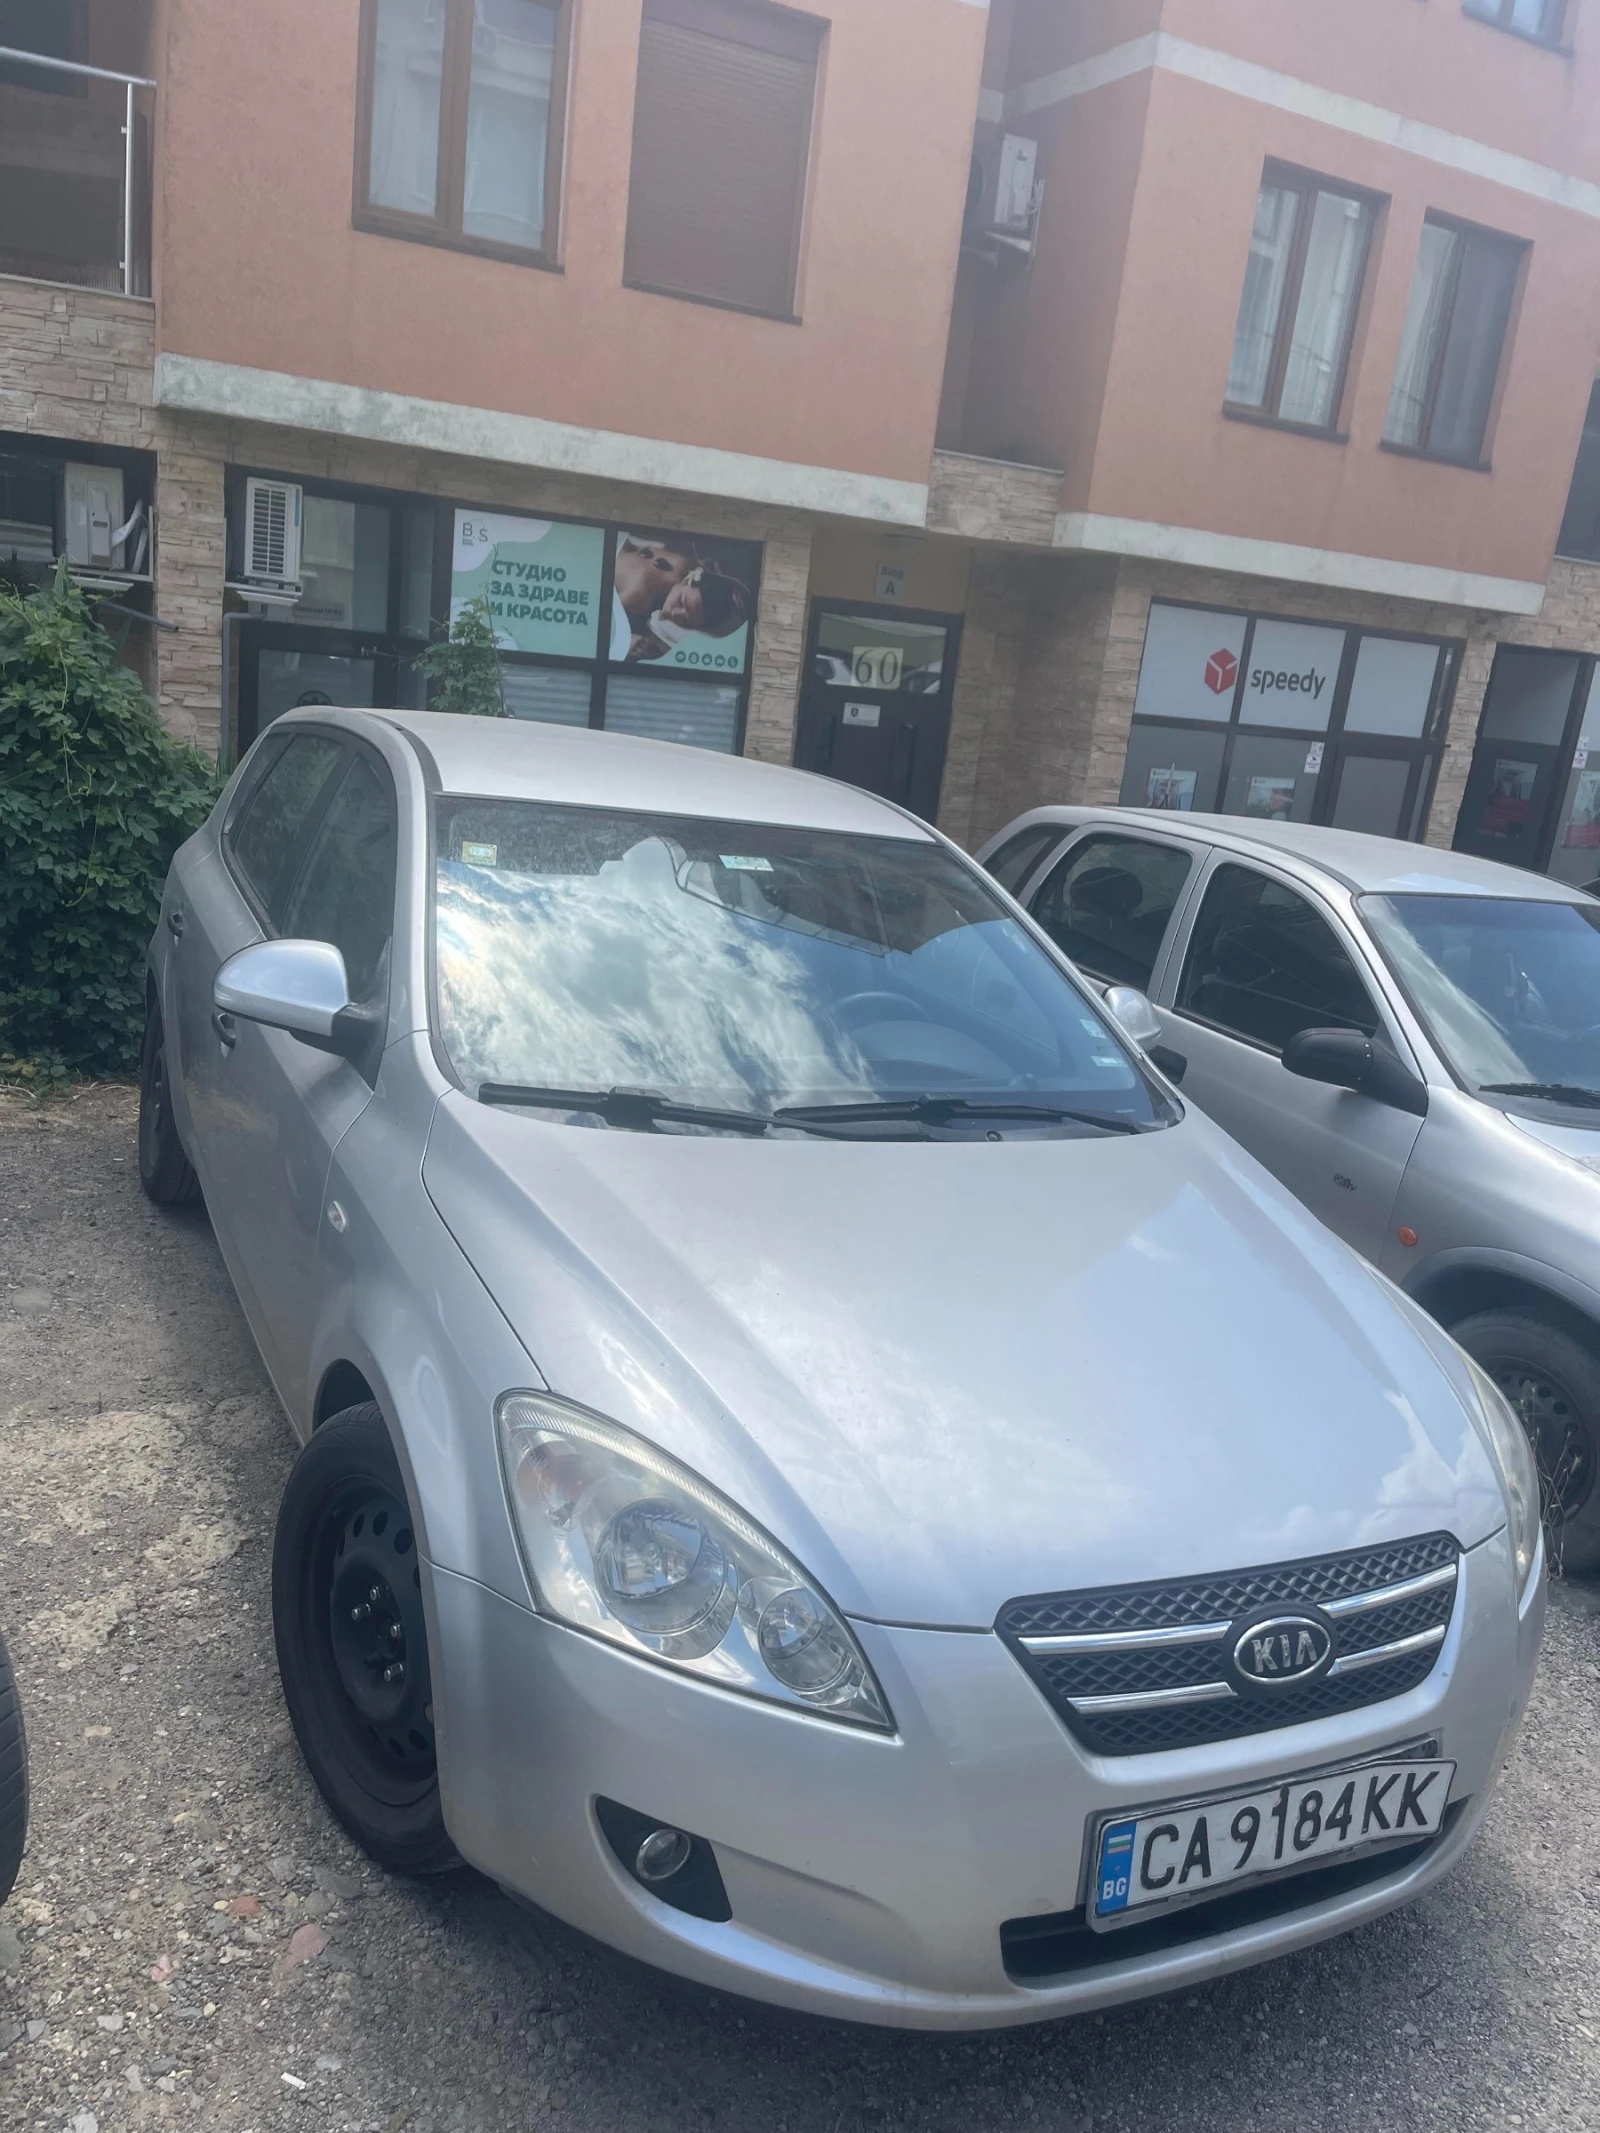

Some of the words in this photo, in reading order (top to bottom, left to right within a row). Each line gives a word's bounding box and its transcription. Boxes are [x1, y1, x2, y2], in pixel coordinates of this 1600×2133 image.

[491, 560, 567, 582] СТУДИО
[490, 580, 515, 597] ЗА
[518, 583, 589, 606] ЗДРАВЕ
[490, 601, 503, 617] И
[506, 602, 588, 626] КРАСОТА
[854, 649, 899, 685] 60
[1250, 667, 1326, 700] speedy
[1251, 1630, 1317, 1673] KIA
[1102, 1876, 1127, 1901] BG
